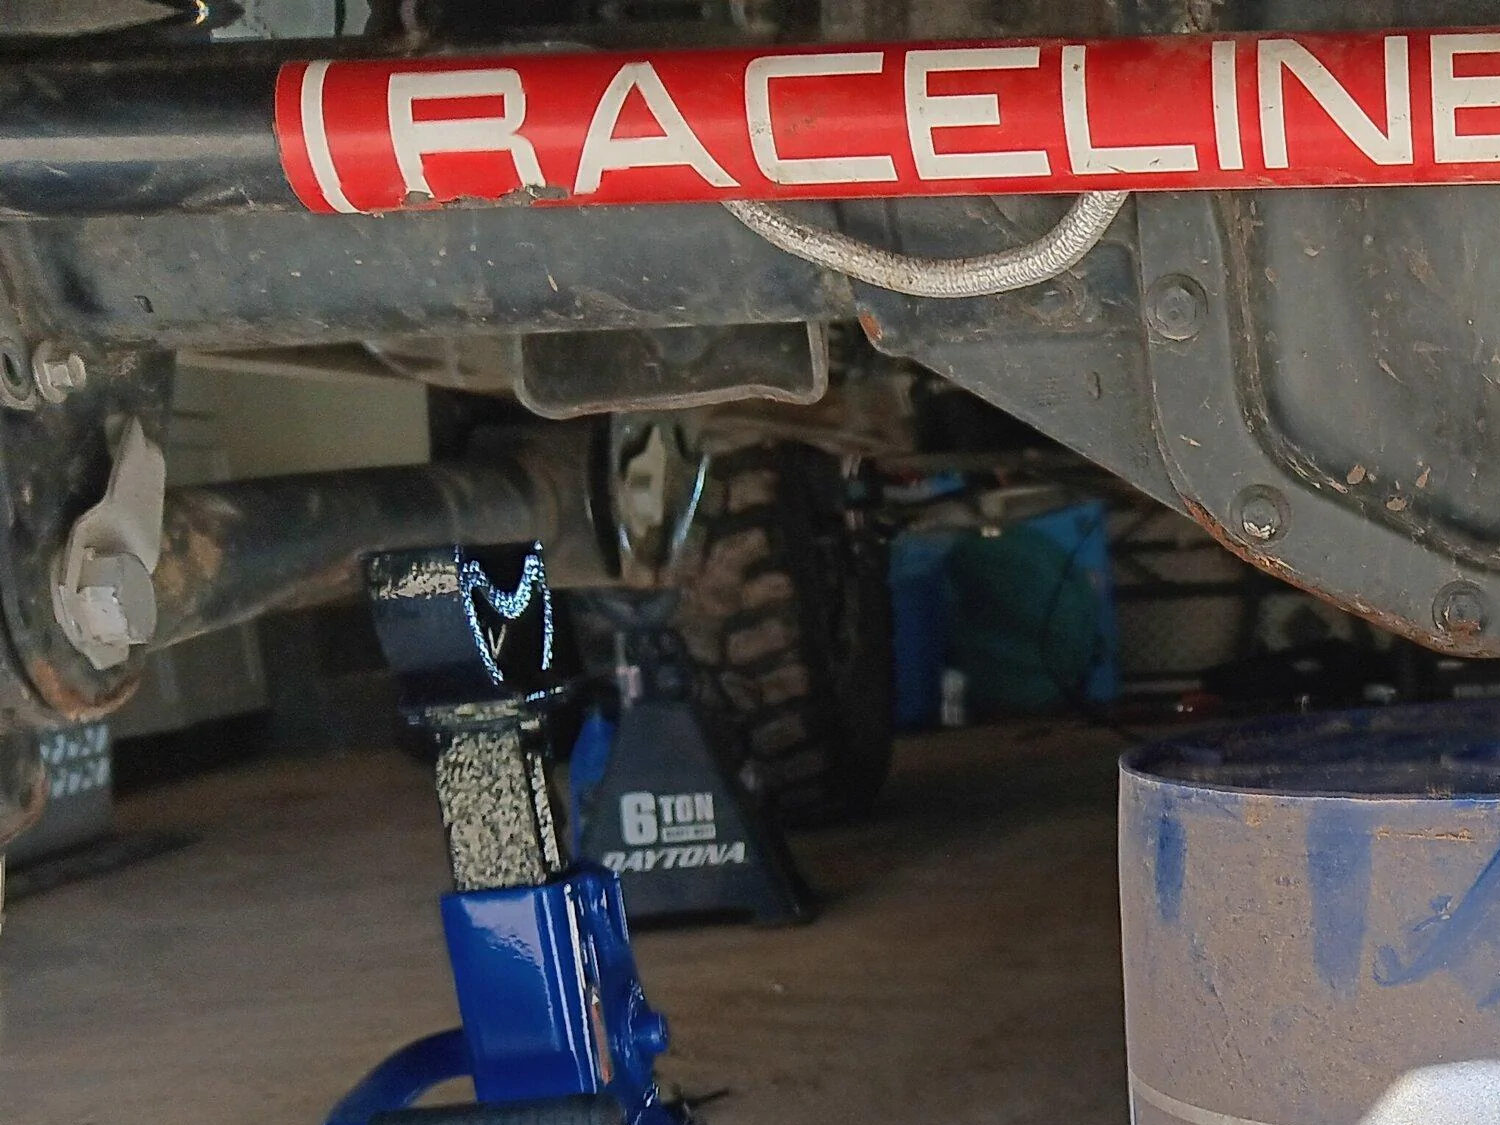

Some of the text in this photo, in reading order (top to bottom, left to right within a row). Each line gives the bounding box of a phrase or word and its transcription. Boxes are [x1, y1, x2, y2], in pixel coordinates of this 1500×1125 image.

[621, 791, 658, 845] 6
[659, 792, 714, 825] TON
[601, 841, 745, 872] DAYTONA
